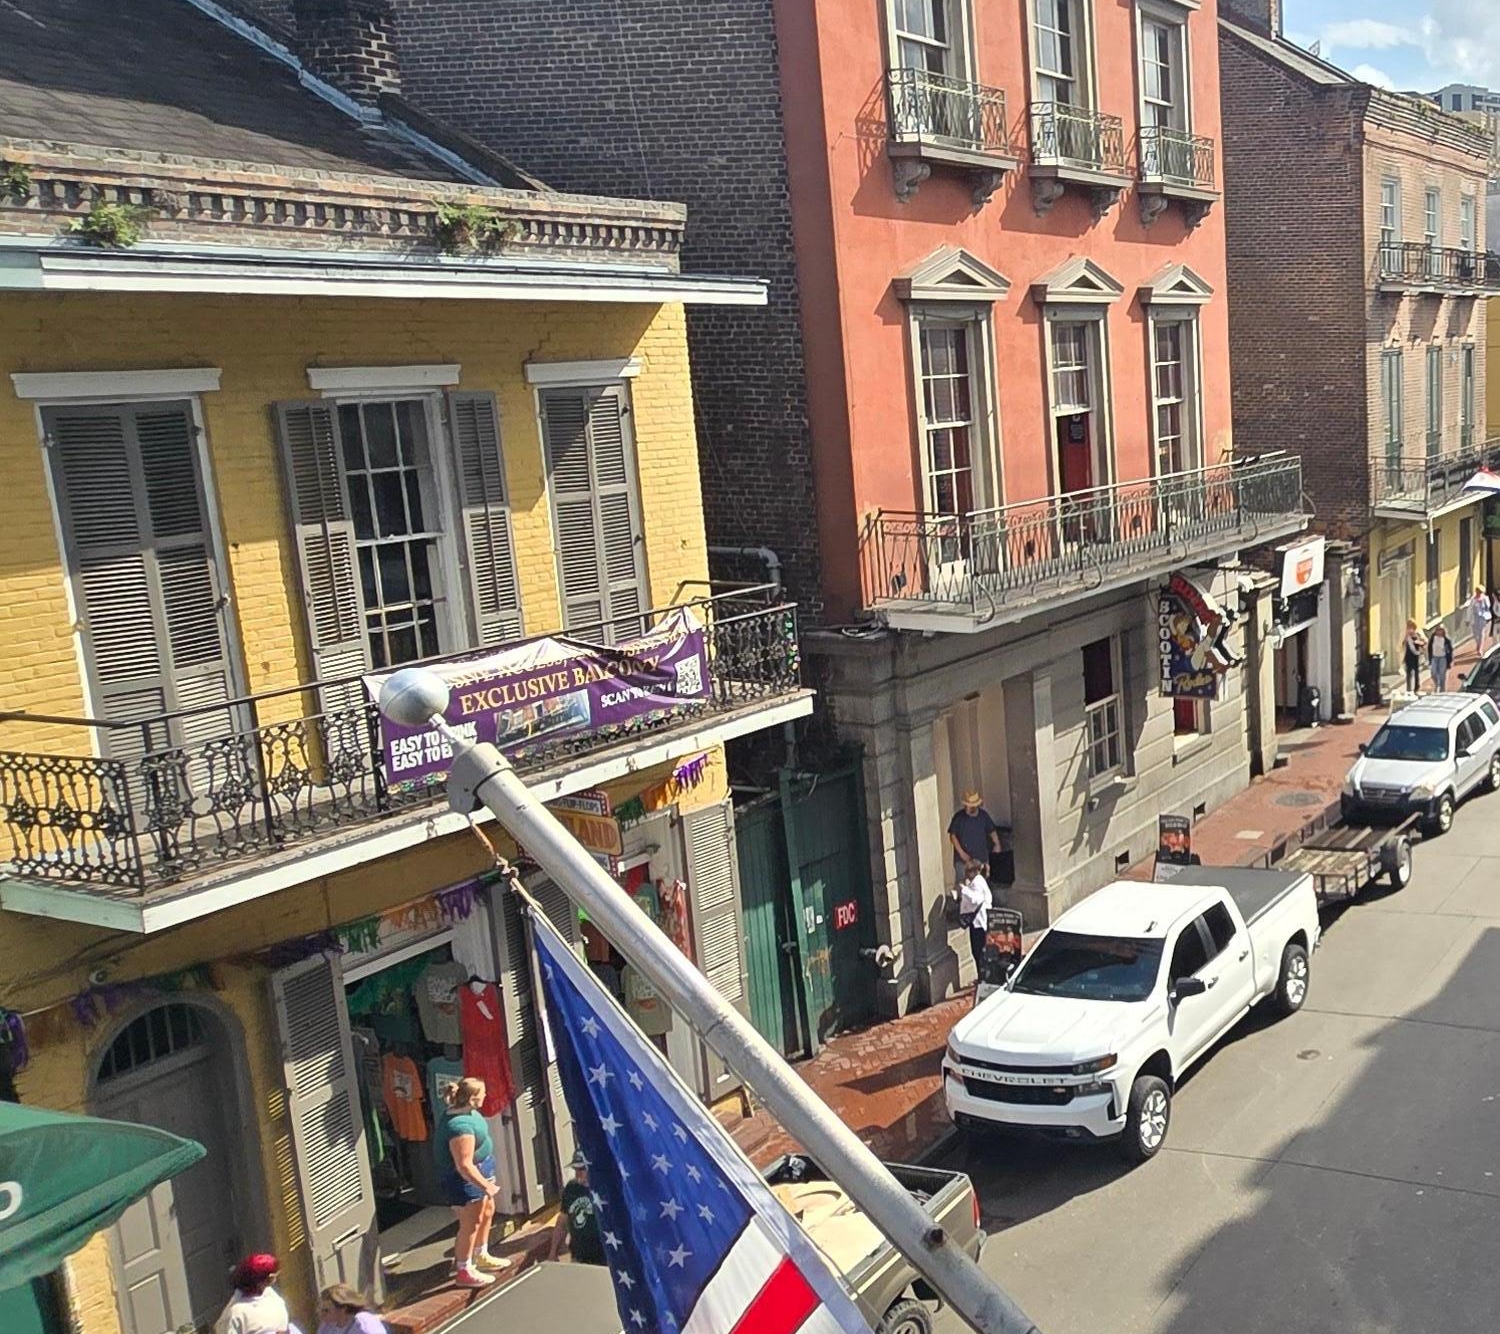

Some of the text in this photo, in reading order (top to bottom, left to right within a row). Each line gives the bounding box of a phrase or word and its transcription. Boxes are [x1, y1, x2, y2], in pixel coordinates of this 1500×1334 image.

[1159, 600, 1173, 692] SCOOTIN
[458, 670, 570, 716] EXCLUSIVE
[600, 687, 630, 708] SCAN
[390, 733, 423, 757] EASY
[423, 730, 440, 748] TO
[391, 749, 424, 772] EASY
[424, 745, 441, 764] TO
[837, 902, 855, 927] FDC
[960, 1067, 1069, 1086] CHEVROLET
